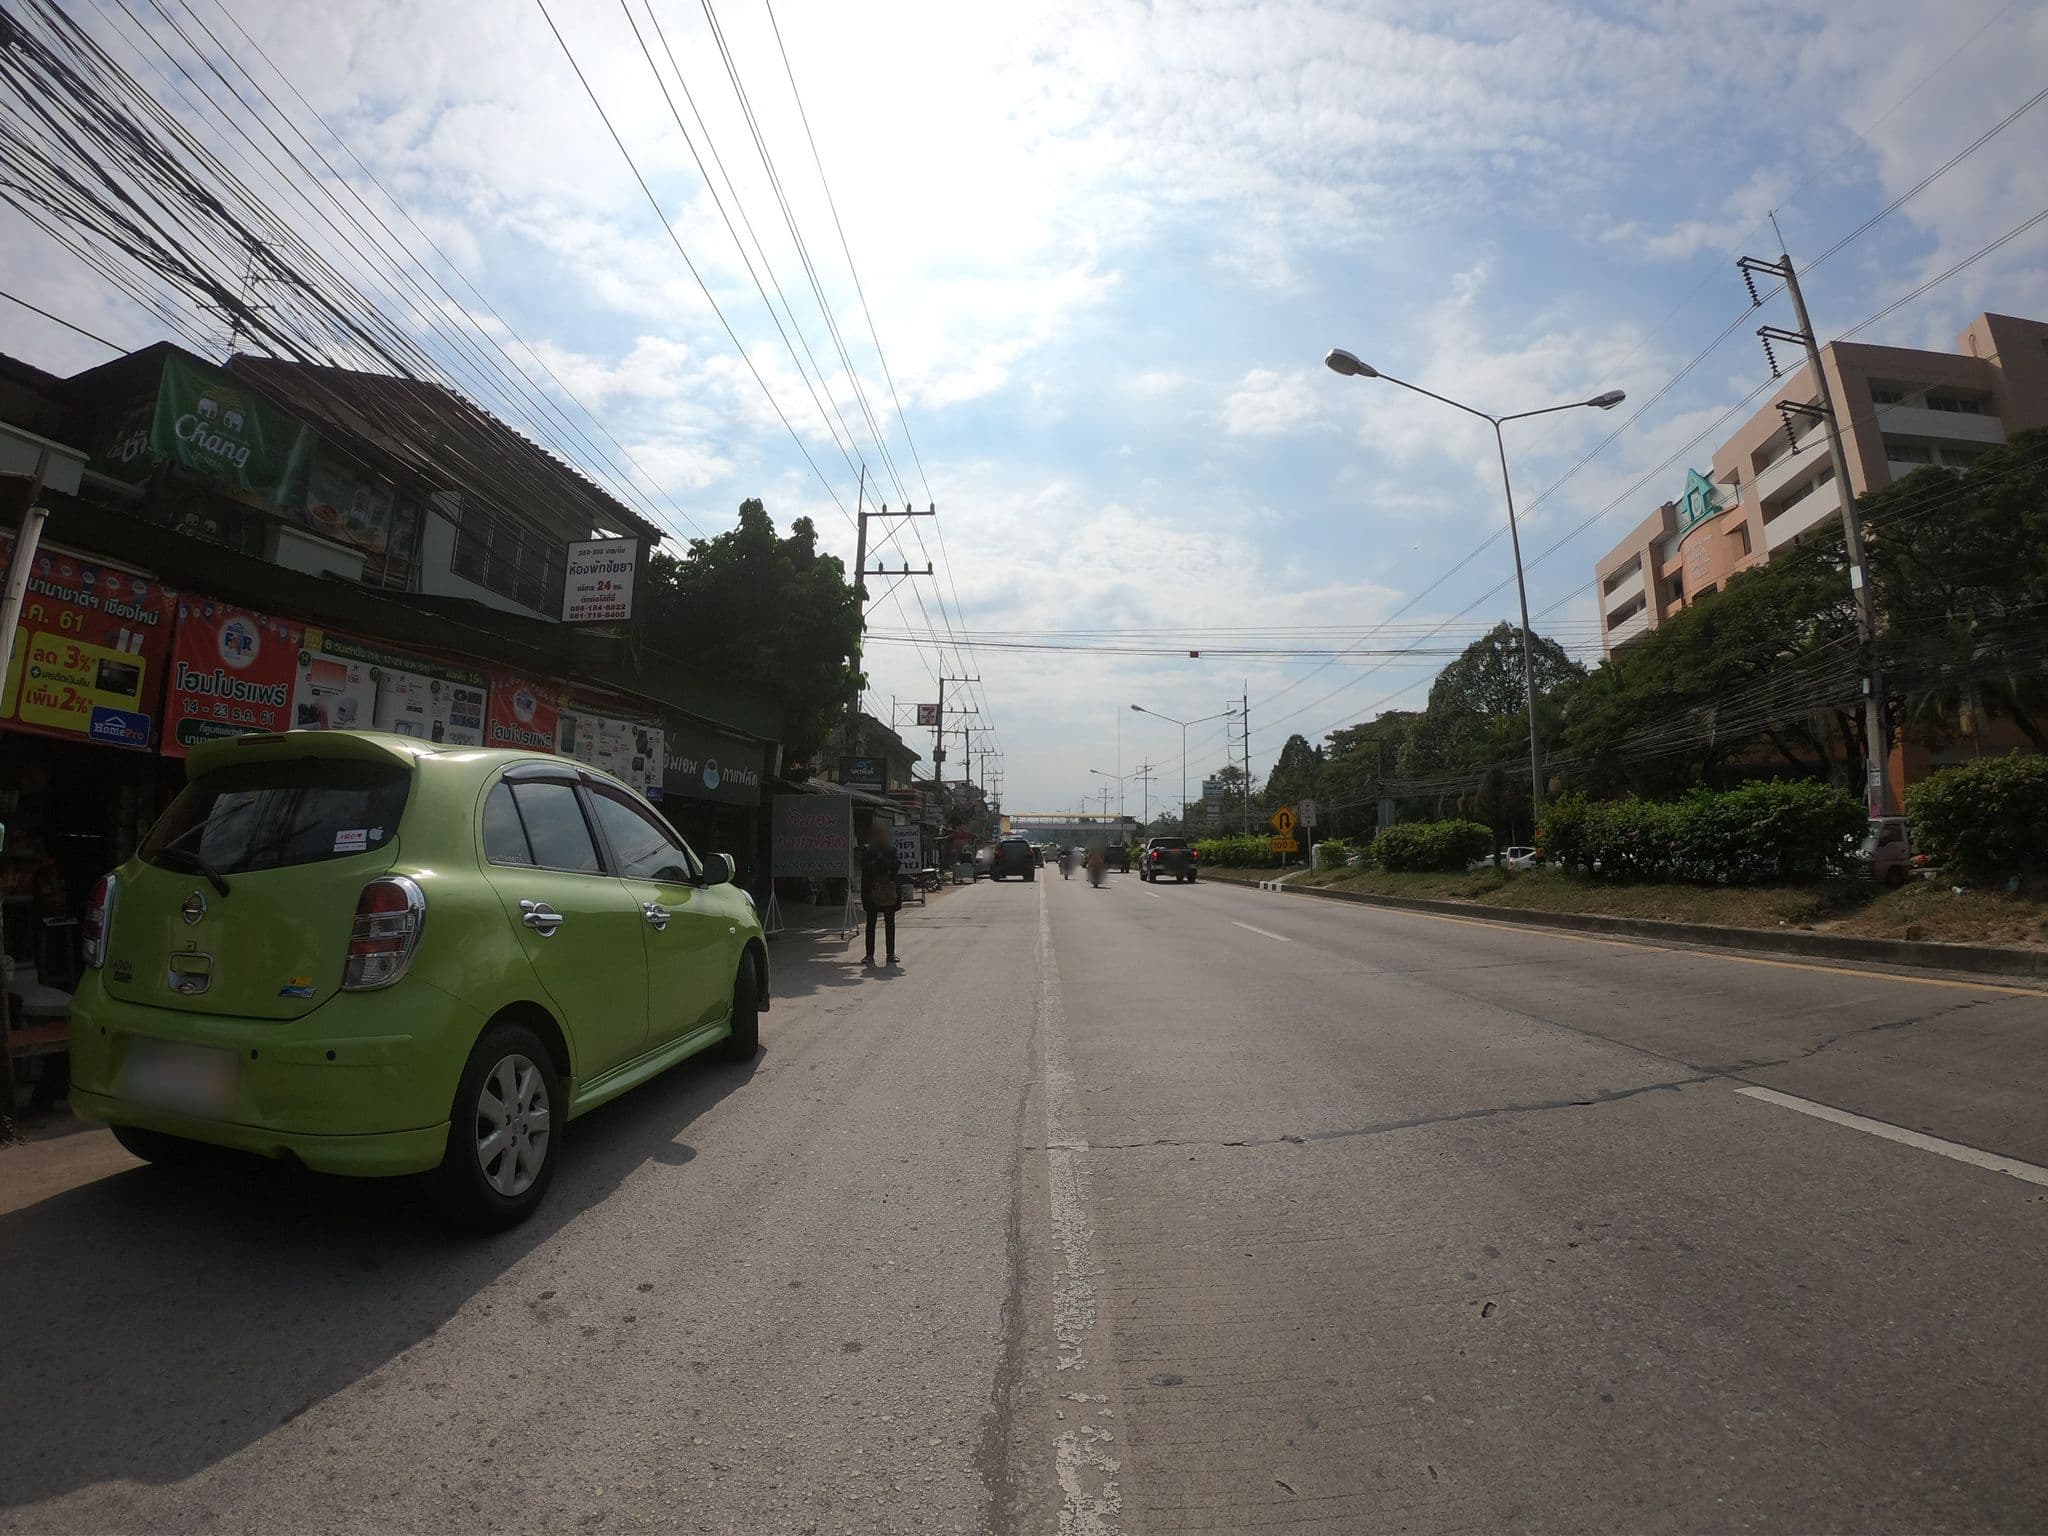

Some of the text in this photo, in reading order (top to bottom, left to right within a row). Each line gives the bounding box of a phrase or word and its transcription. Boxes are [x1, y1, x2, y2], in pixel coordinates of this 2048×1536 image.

[175, 413, 252, 469] Chang
[597, 580, 611, 591] 24
[59, 610, 84, 632] 61
[33, 648, 57, 665] ลด
[184, 698, 199, 715] 14
[215, 703, 228, 718] 23
[260, 711, 275, 726] 61
